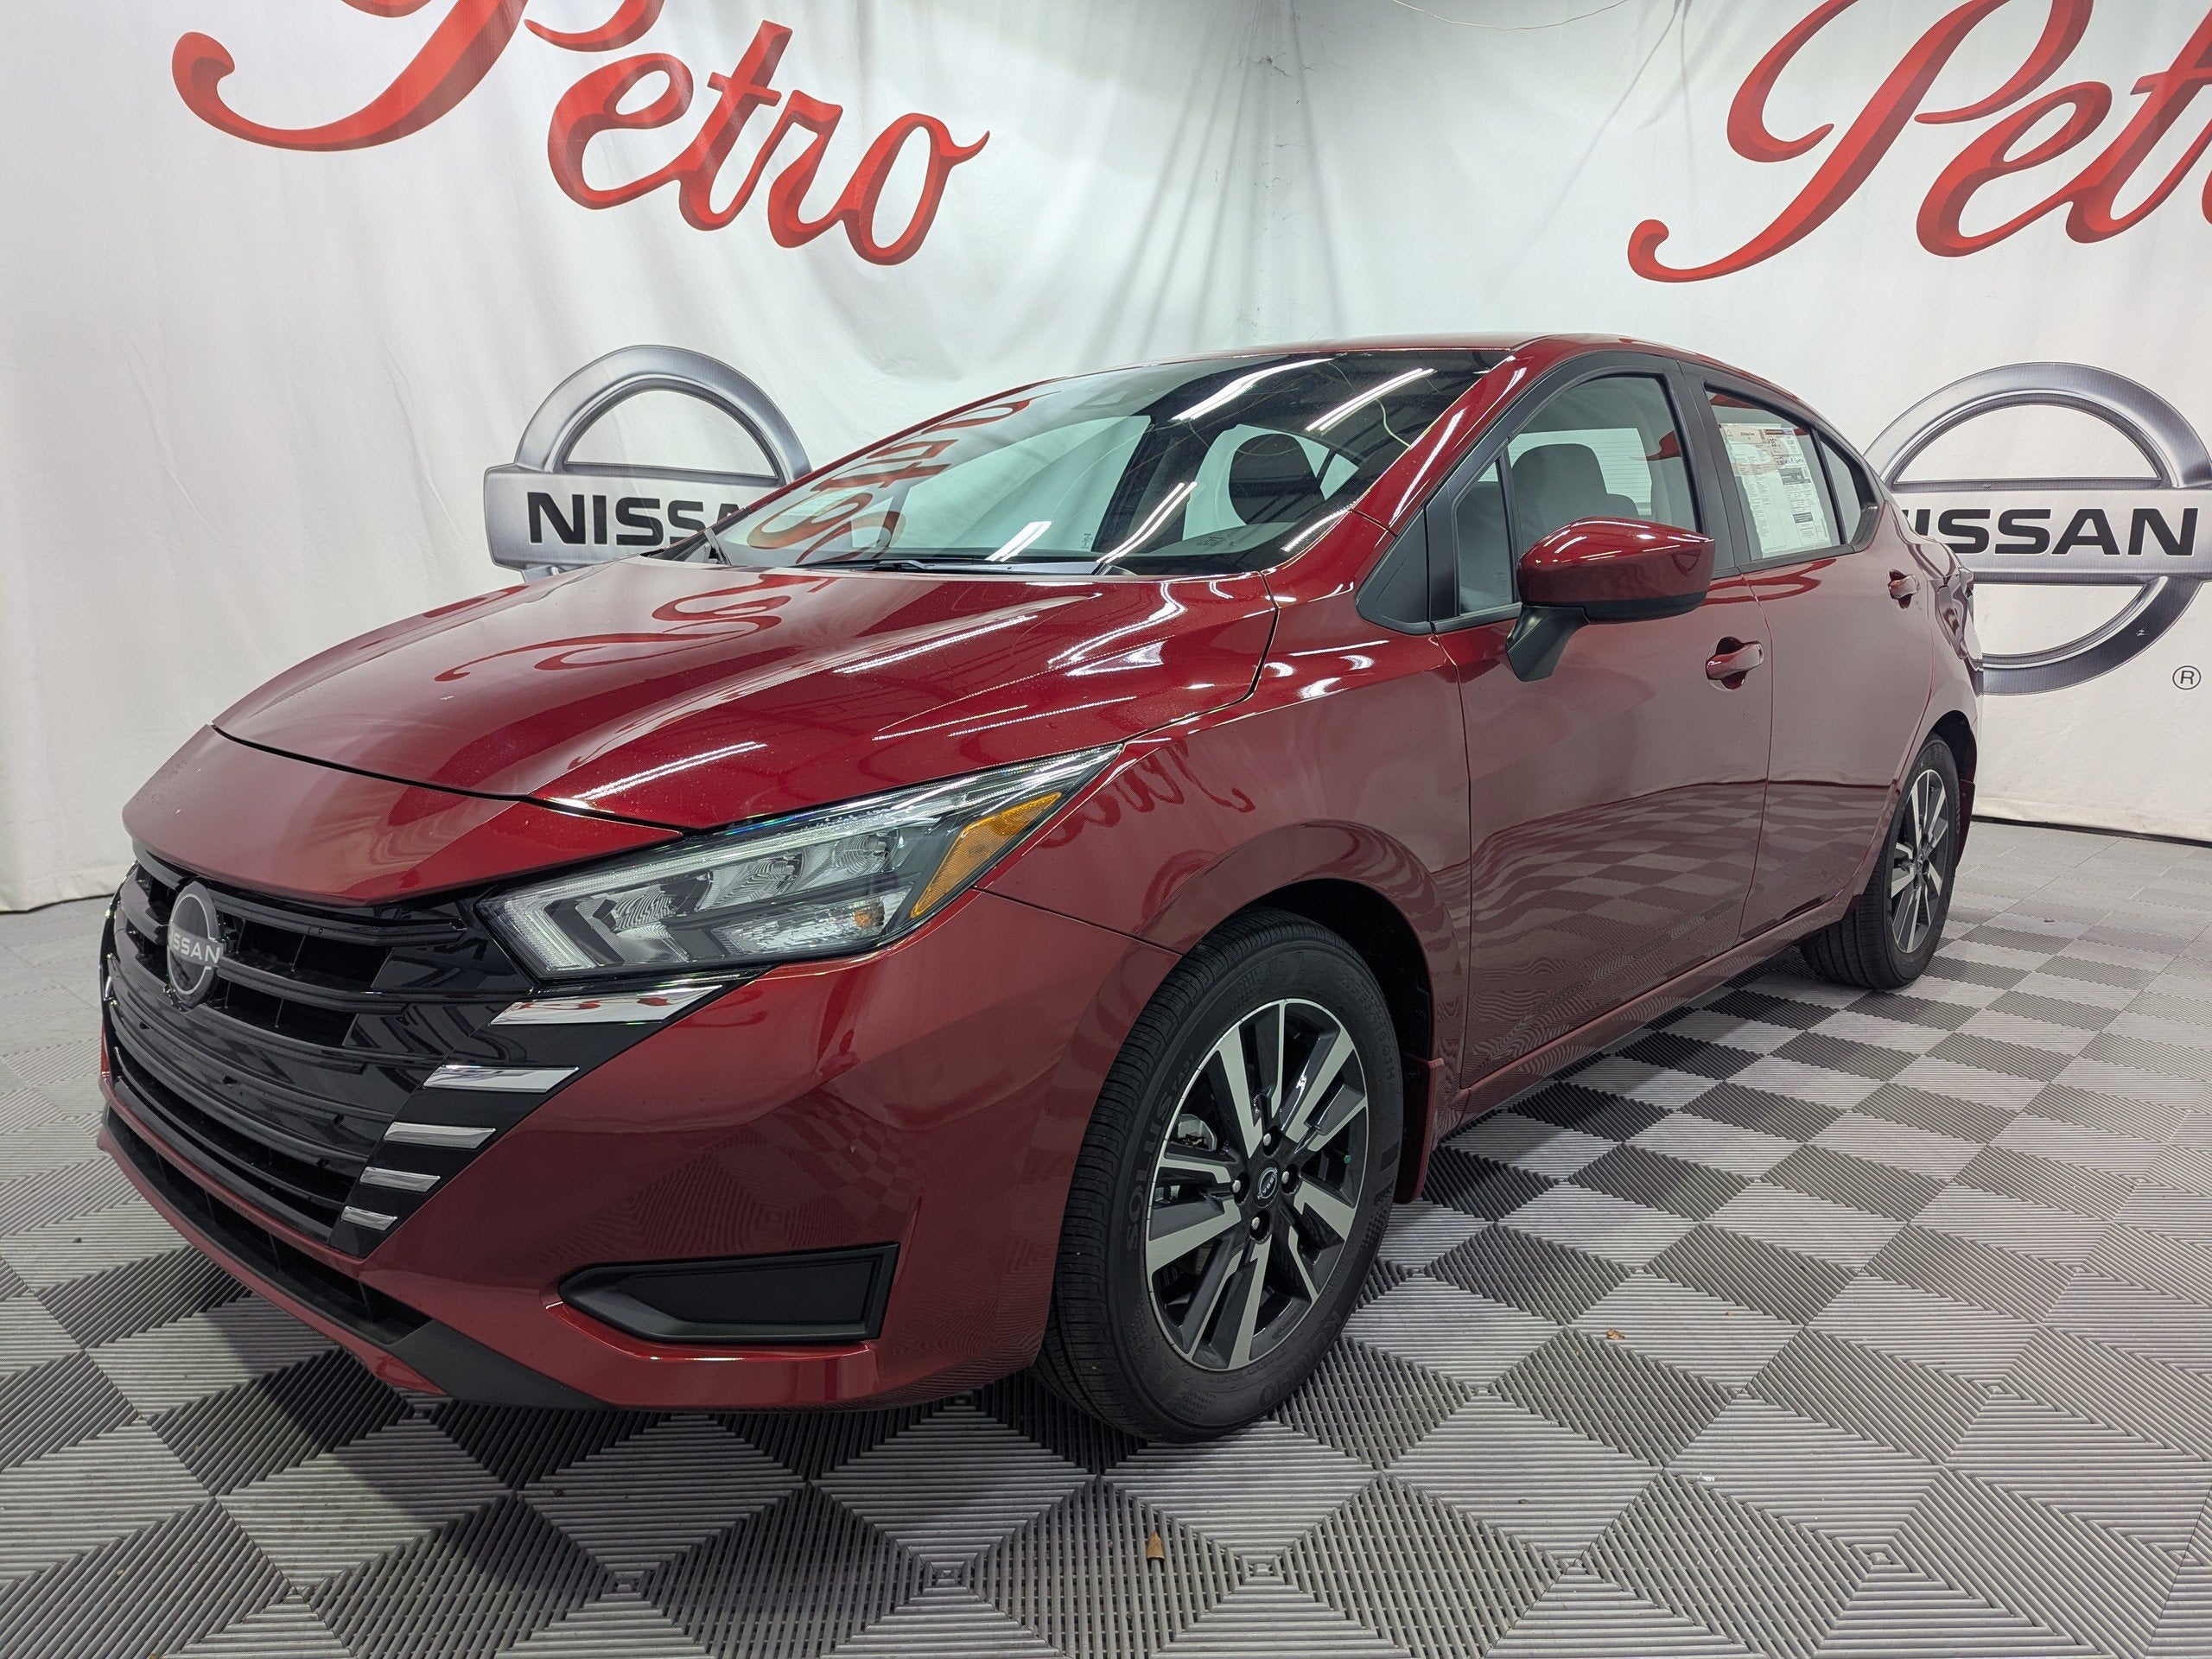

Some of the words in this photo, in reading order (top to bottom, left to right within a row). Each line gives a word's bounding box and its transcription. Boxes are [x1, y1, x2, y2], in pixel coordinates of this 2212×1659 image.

[1628, 0, 2212, 283] Pet
[527, 492, 745, 546] NISS
[1904, 507, 2199, 556] ISSAN
[1127, 1091, 1173, 1252] SOLUS
